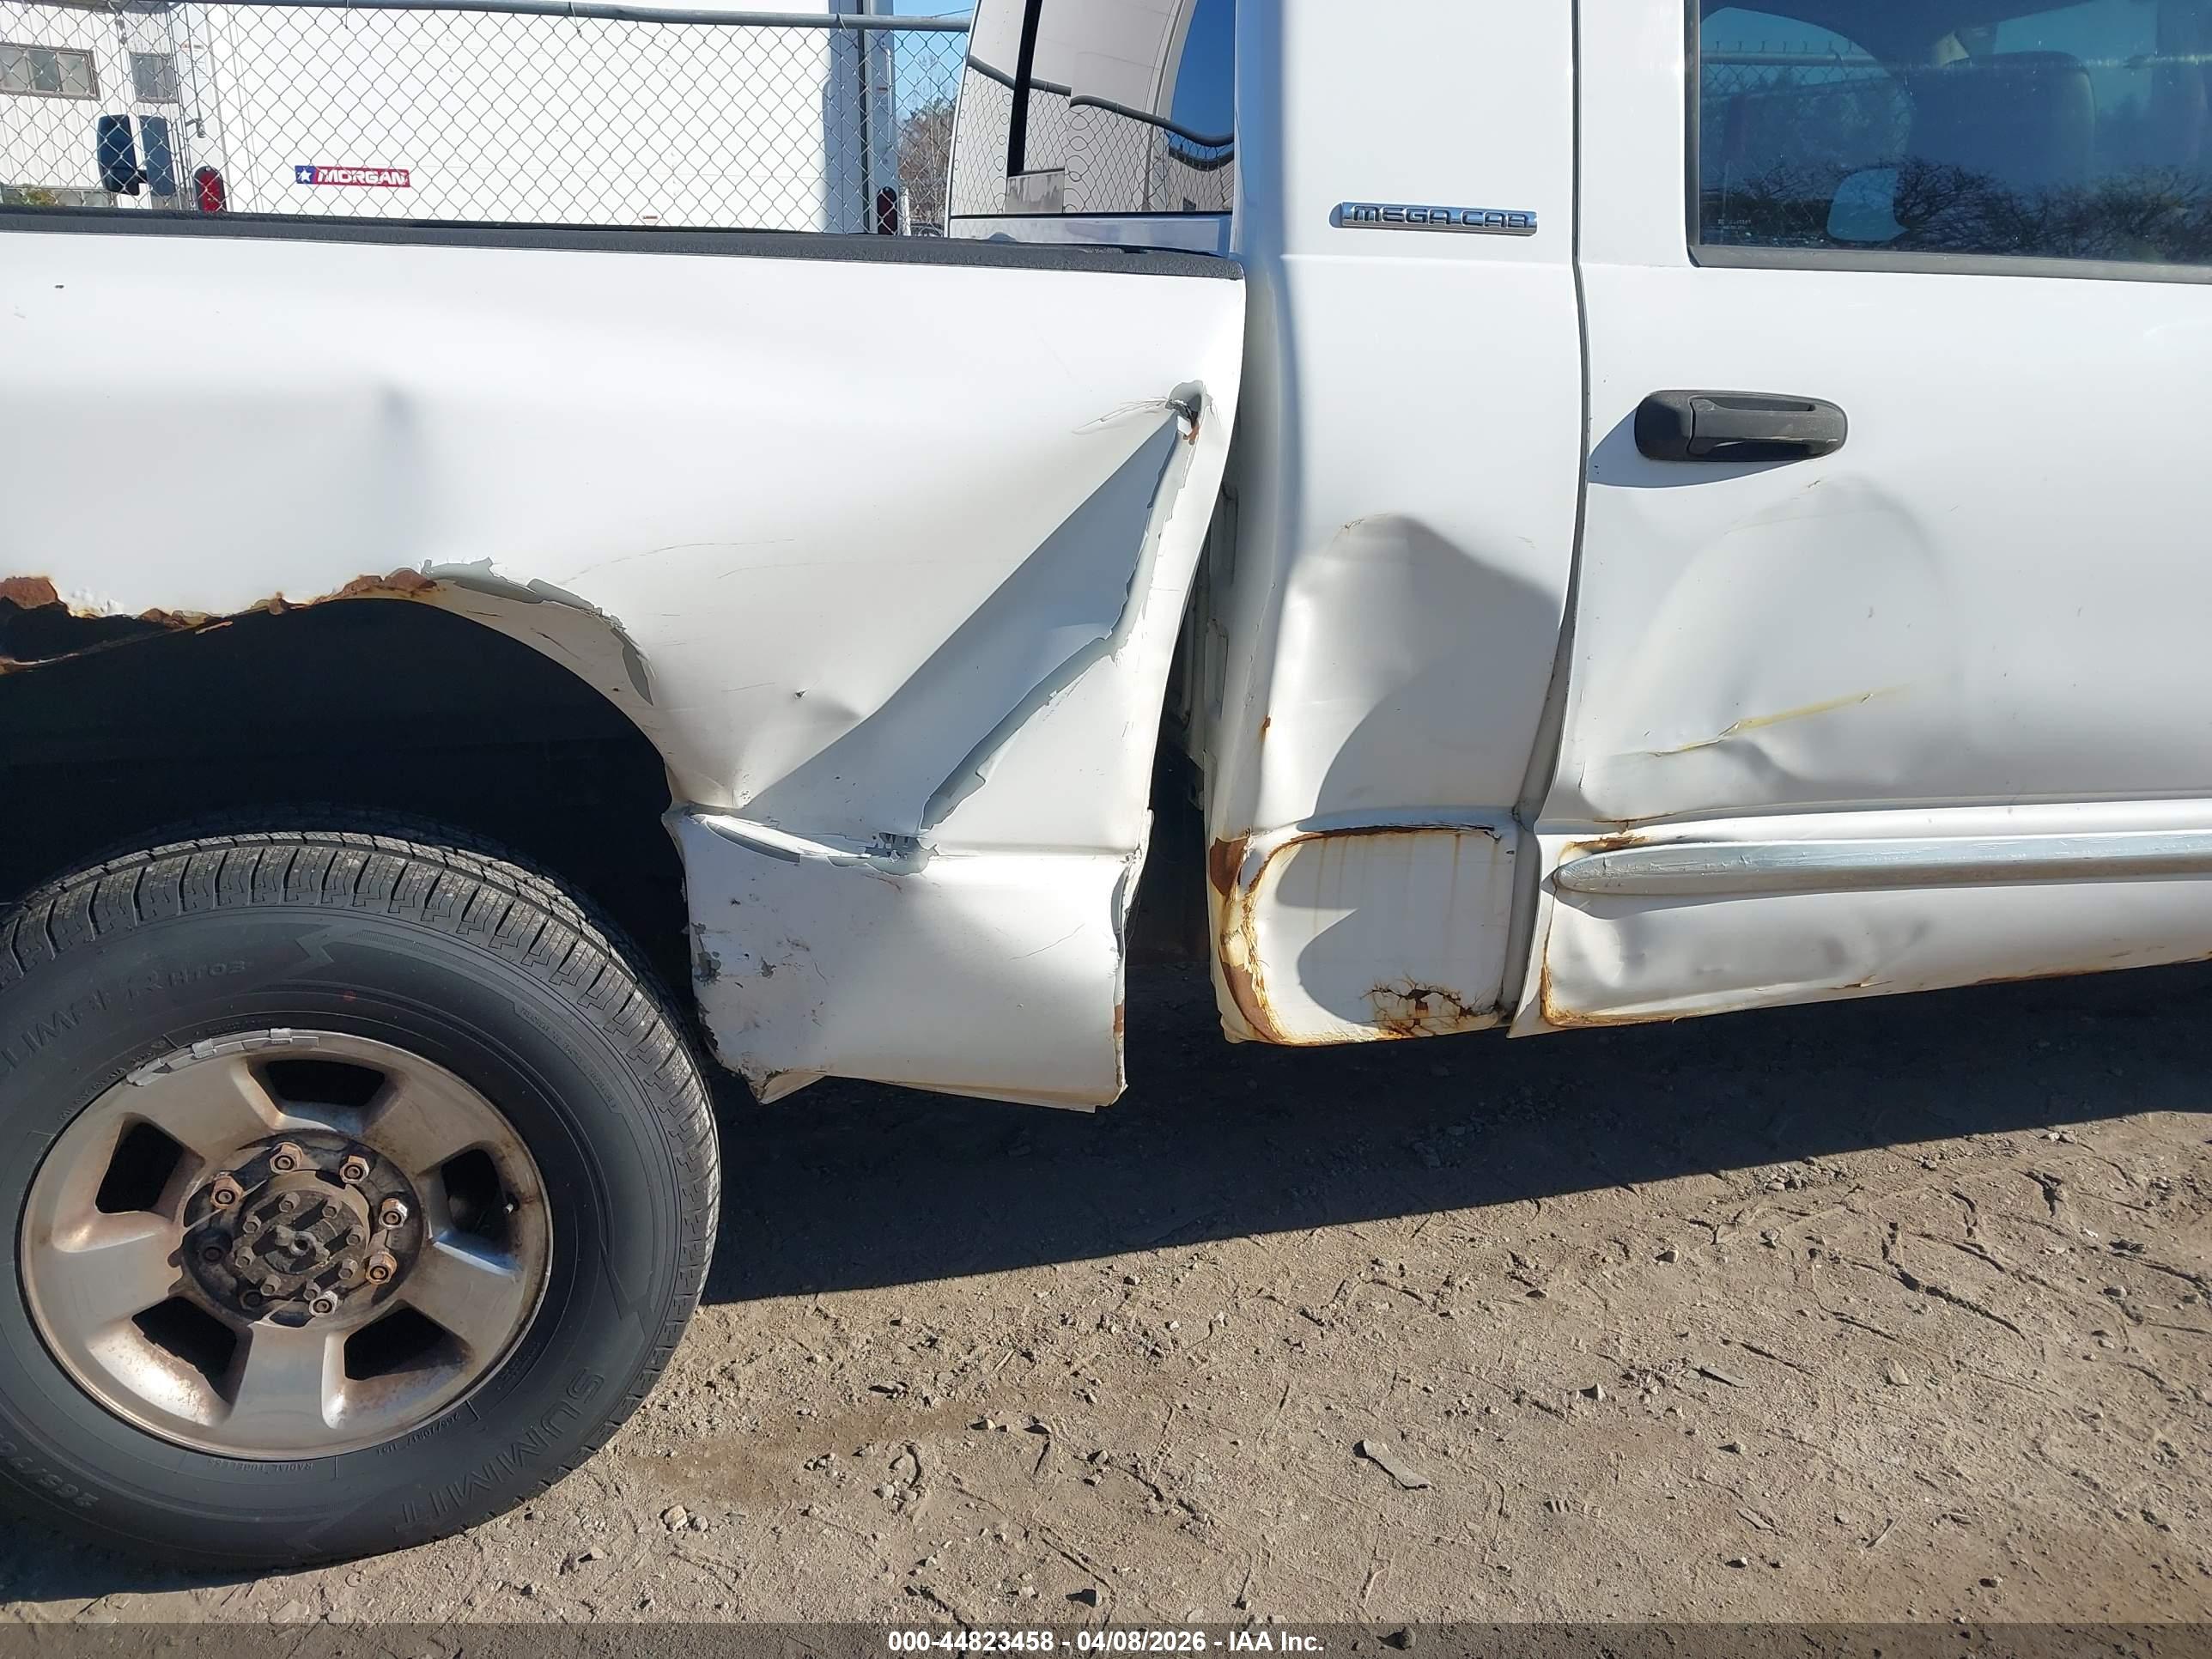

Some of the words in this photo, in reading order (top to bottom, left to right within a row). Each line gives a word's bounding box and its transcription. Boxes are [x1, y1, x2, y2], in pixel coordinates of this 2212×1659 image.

[317, 168, 409, 185] MORGAN
[1352, 205, 1451, 227] MEGA
[1462, 210, 1528, 229] CAB
[401, 1368, 605, 1524] SUMMIT
